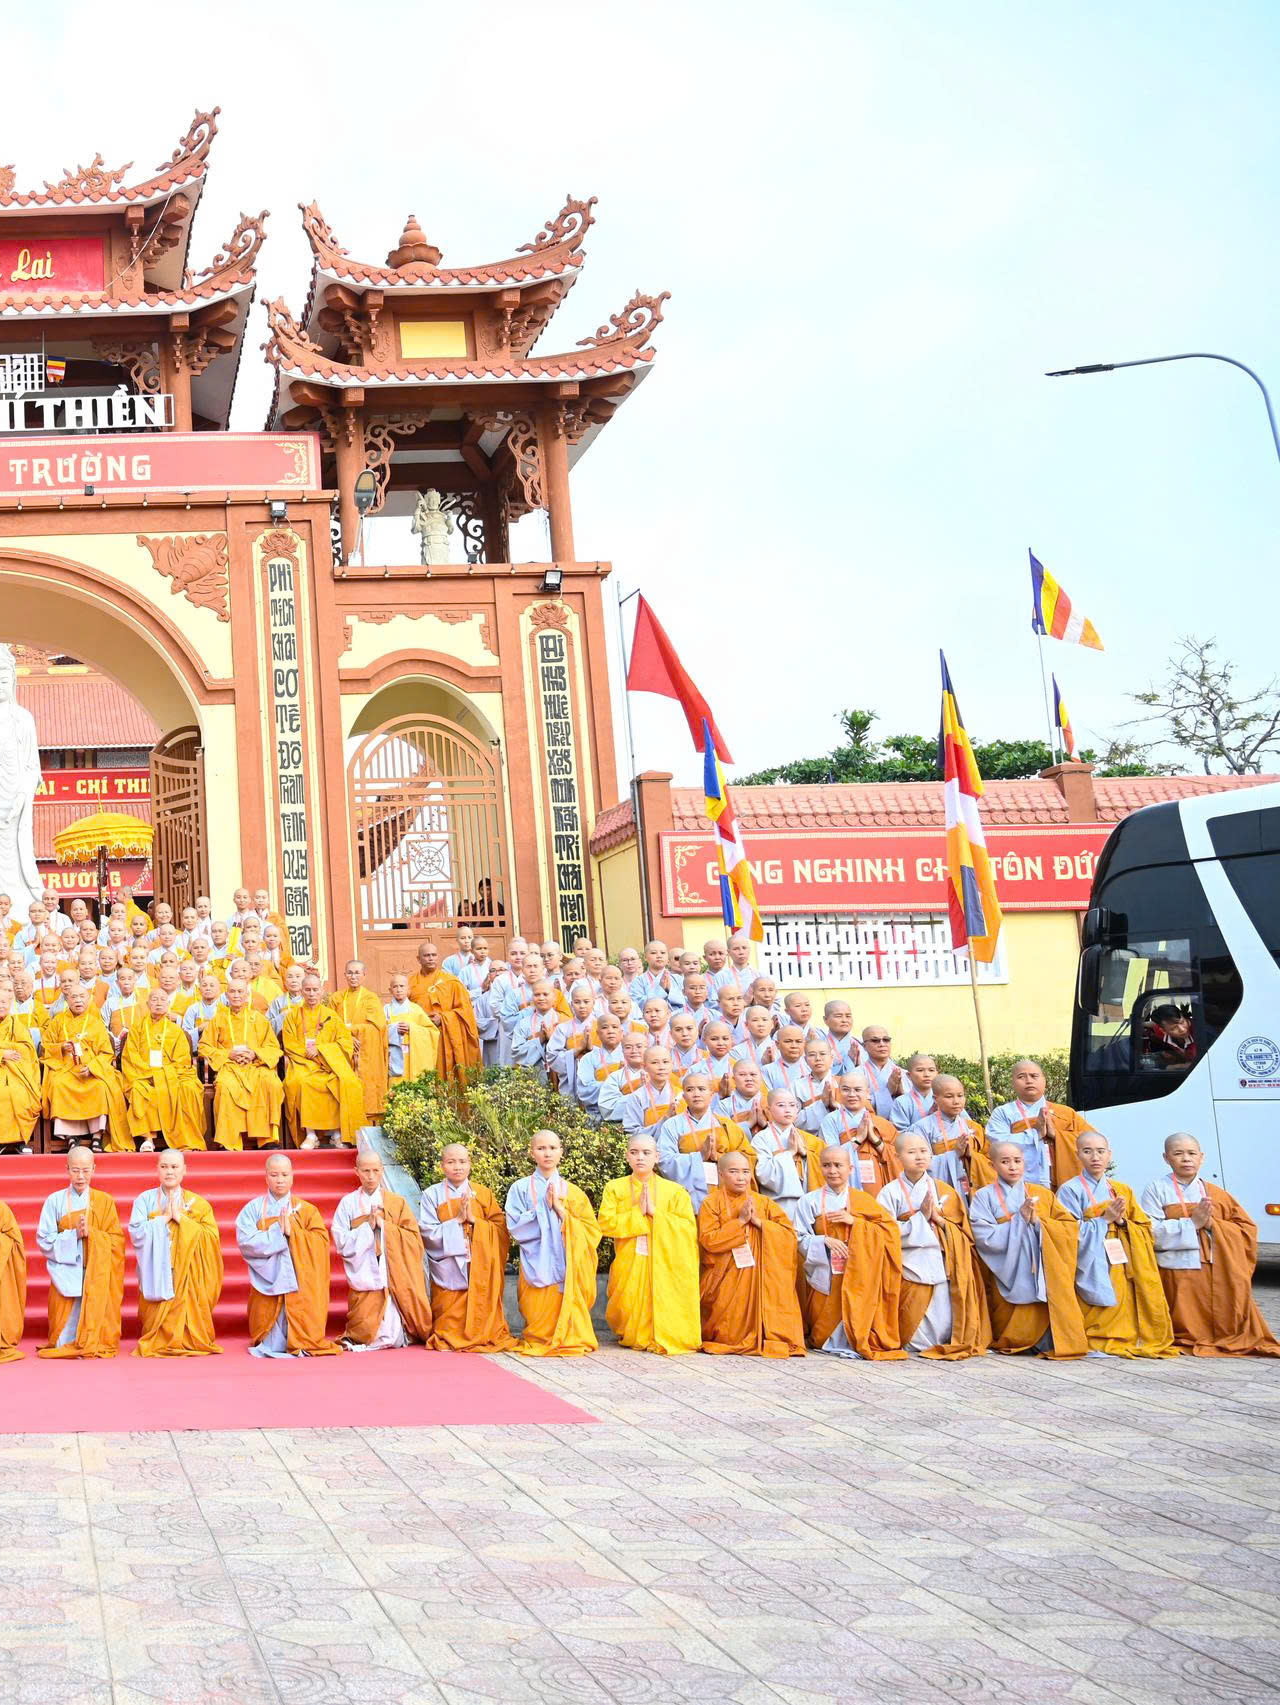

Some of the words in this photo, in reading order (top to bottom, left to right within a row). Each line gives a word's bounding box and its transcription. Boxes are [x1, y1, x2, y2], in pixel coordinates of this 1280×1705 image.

[10, 248, 55, 282] Lai
[34, 384, 165, 429] THIỀN
[8, 451, 152, 487] TRƯỜNG
[36, 780, 55, 795] AI
[76, 776, 108, 794] CHÍ
[114, 778, 150, 794] THI
[792, 858, 906, 883] NGHINH
[915, 857, 949, 882] CH
[989, 851, 1043, 881] TÔN
[1052, 850, 1100, 880] ĐỨ
